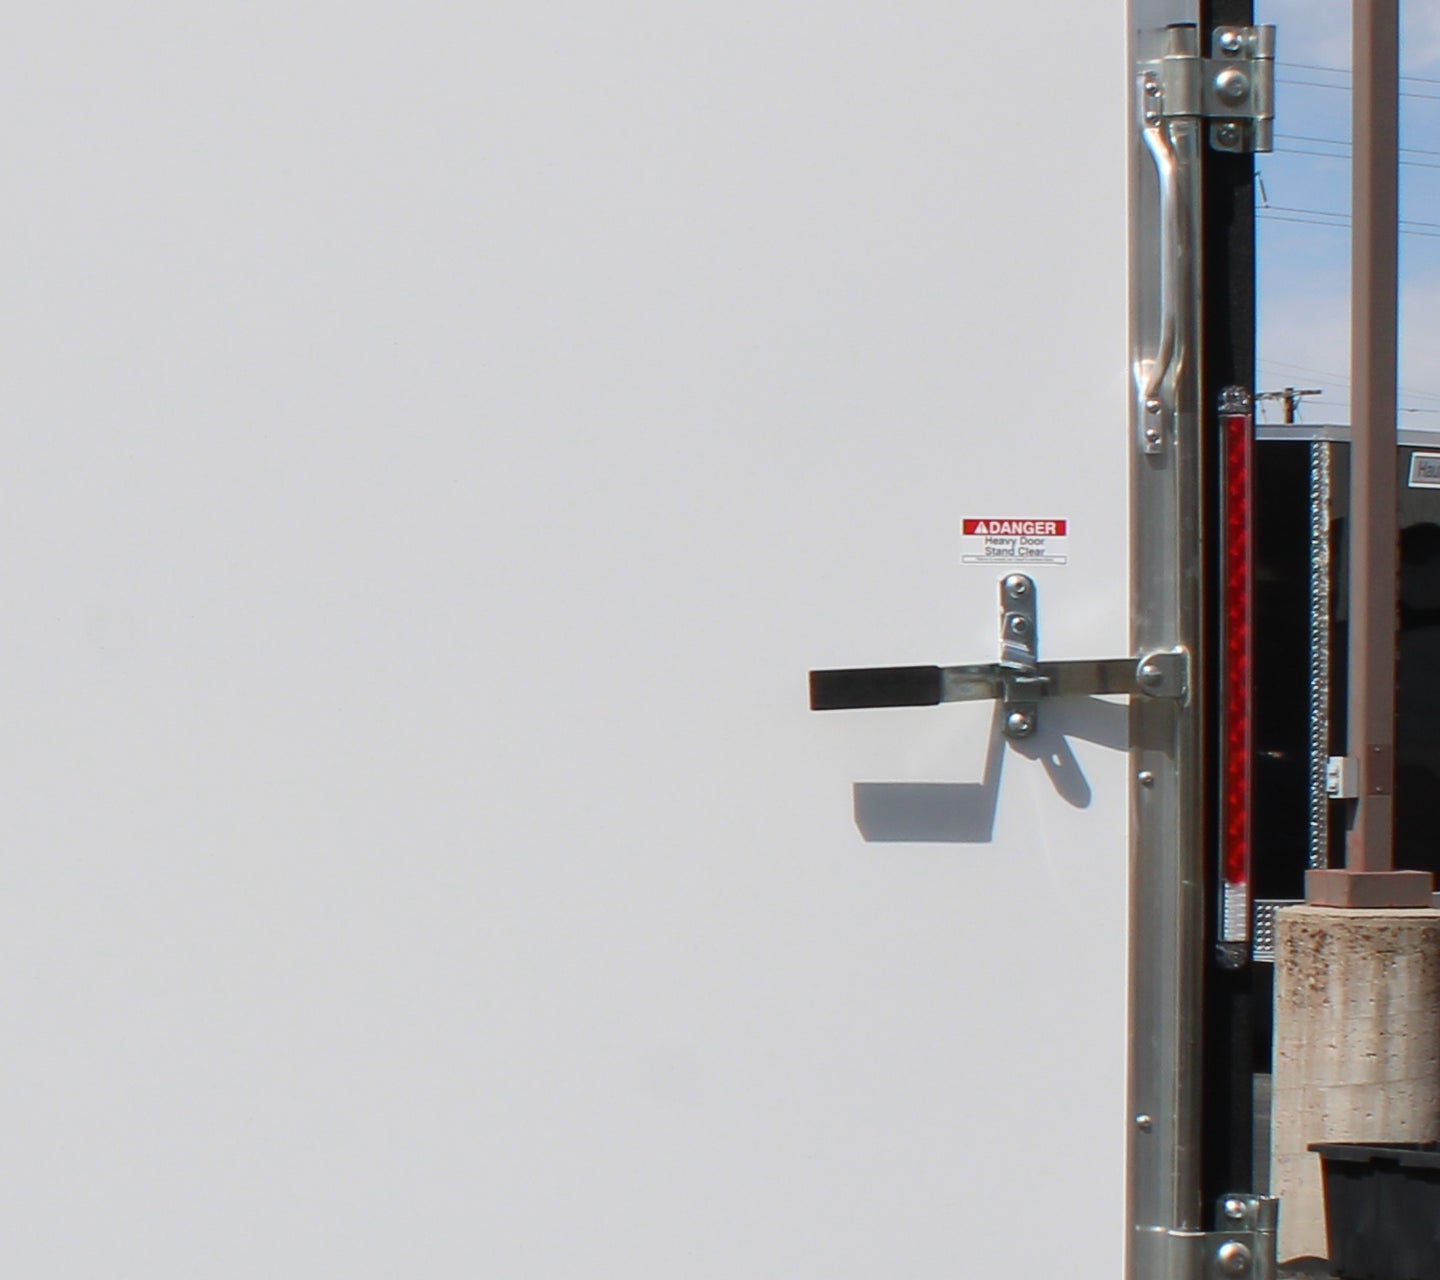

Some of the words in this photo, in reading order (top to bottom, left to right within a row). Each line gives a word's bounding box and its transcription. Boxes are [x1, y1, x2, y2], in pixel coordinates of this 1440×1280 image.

[989, 521, 1056, 535] DANGER
[985, 536, 1017, 547] Heavy
[1020, 537, 1045, 546] Door
[985, 547, 1014, 556] Stand
[1018, 547, 1045, 556] Clear
